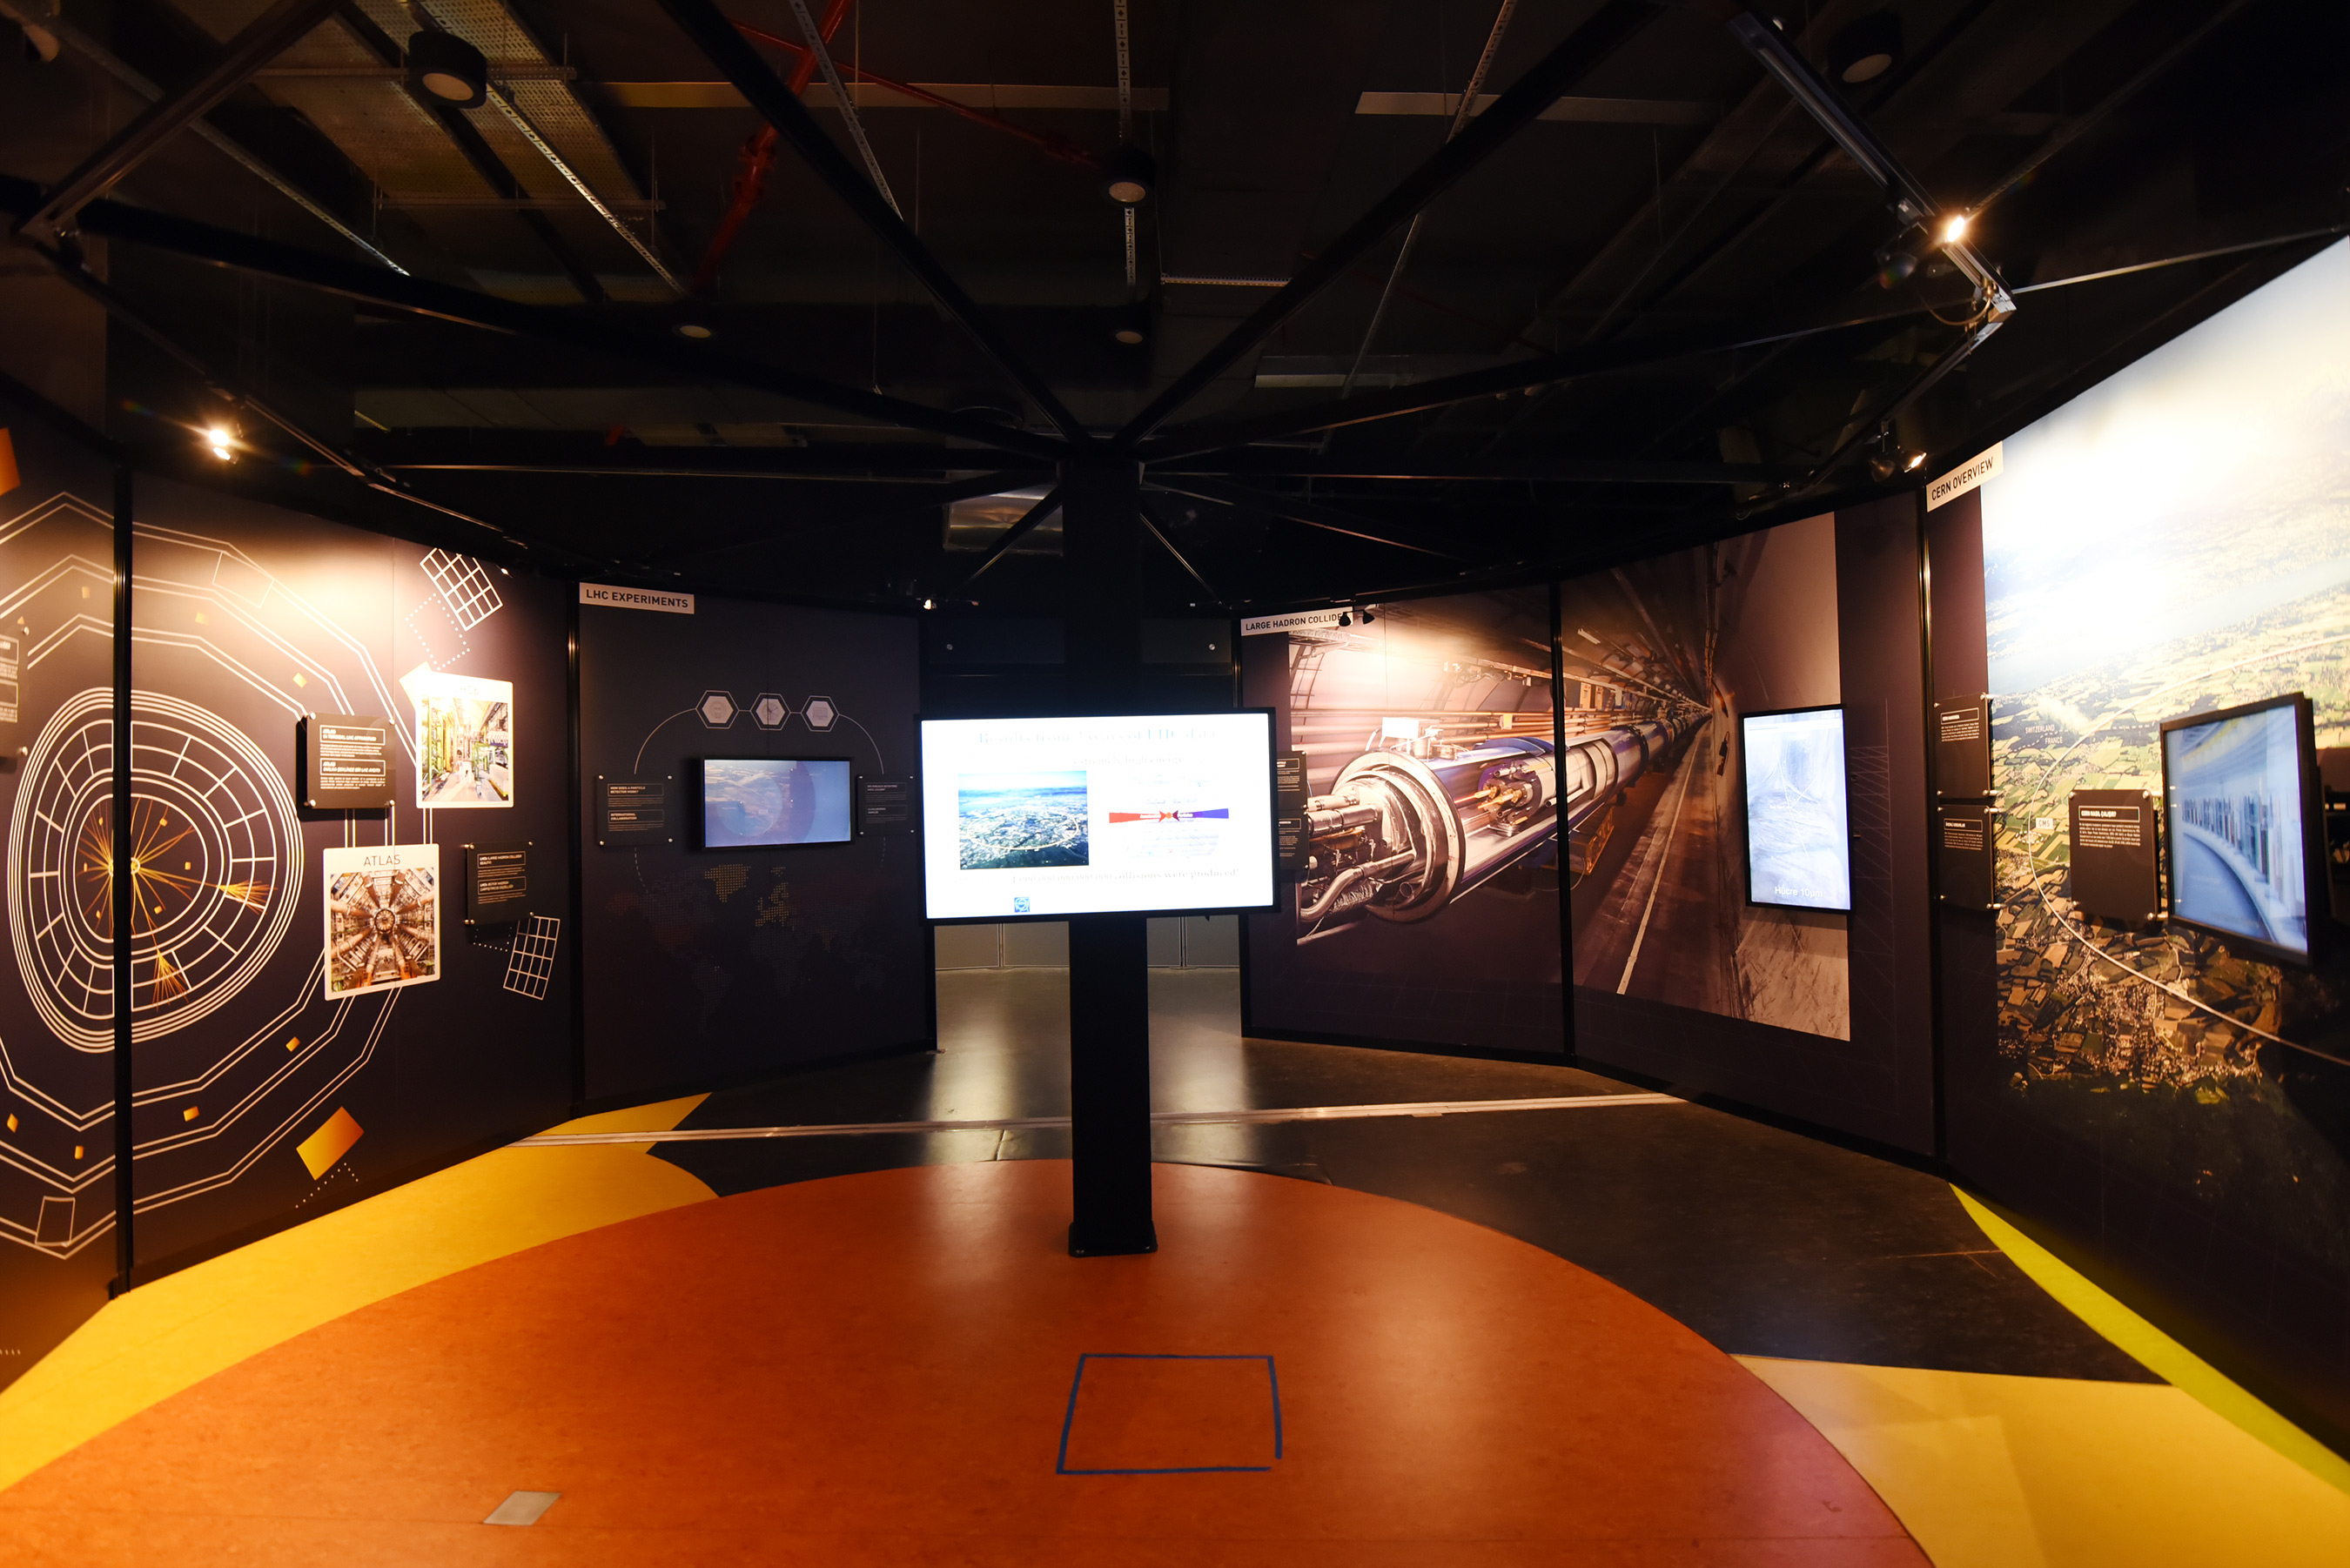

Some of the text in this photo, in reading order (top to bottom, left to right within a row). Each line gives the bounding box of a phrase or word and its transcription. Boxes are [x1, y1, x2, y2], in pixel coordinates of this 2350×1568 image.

[1931, 456, 1993, 500] CERN OVERVIEW
[586, 589, 688, 608] LHC EXPERIMENTS
[1246, 613, 1343, 631] LARGE HADRON COLLIDE
[2025, 724, 2056, 734] SWITZERLAND
[2044, 735, 2063, 745] FRANCE
[363, 854, 400, 867] ATLAS
